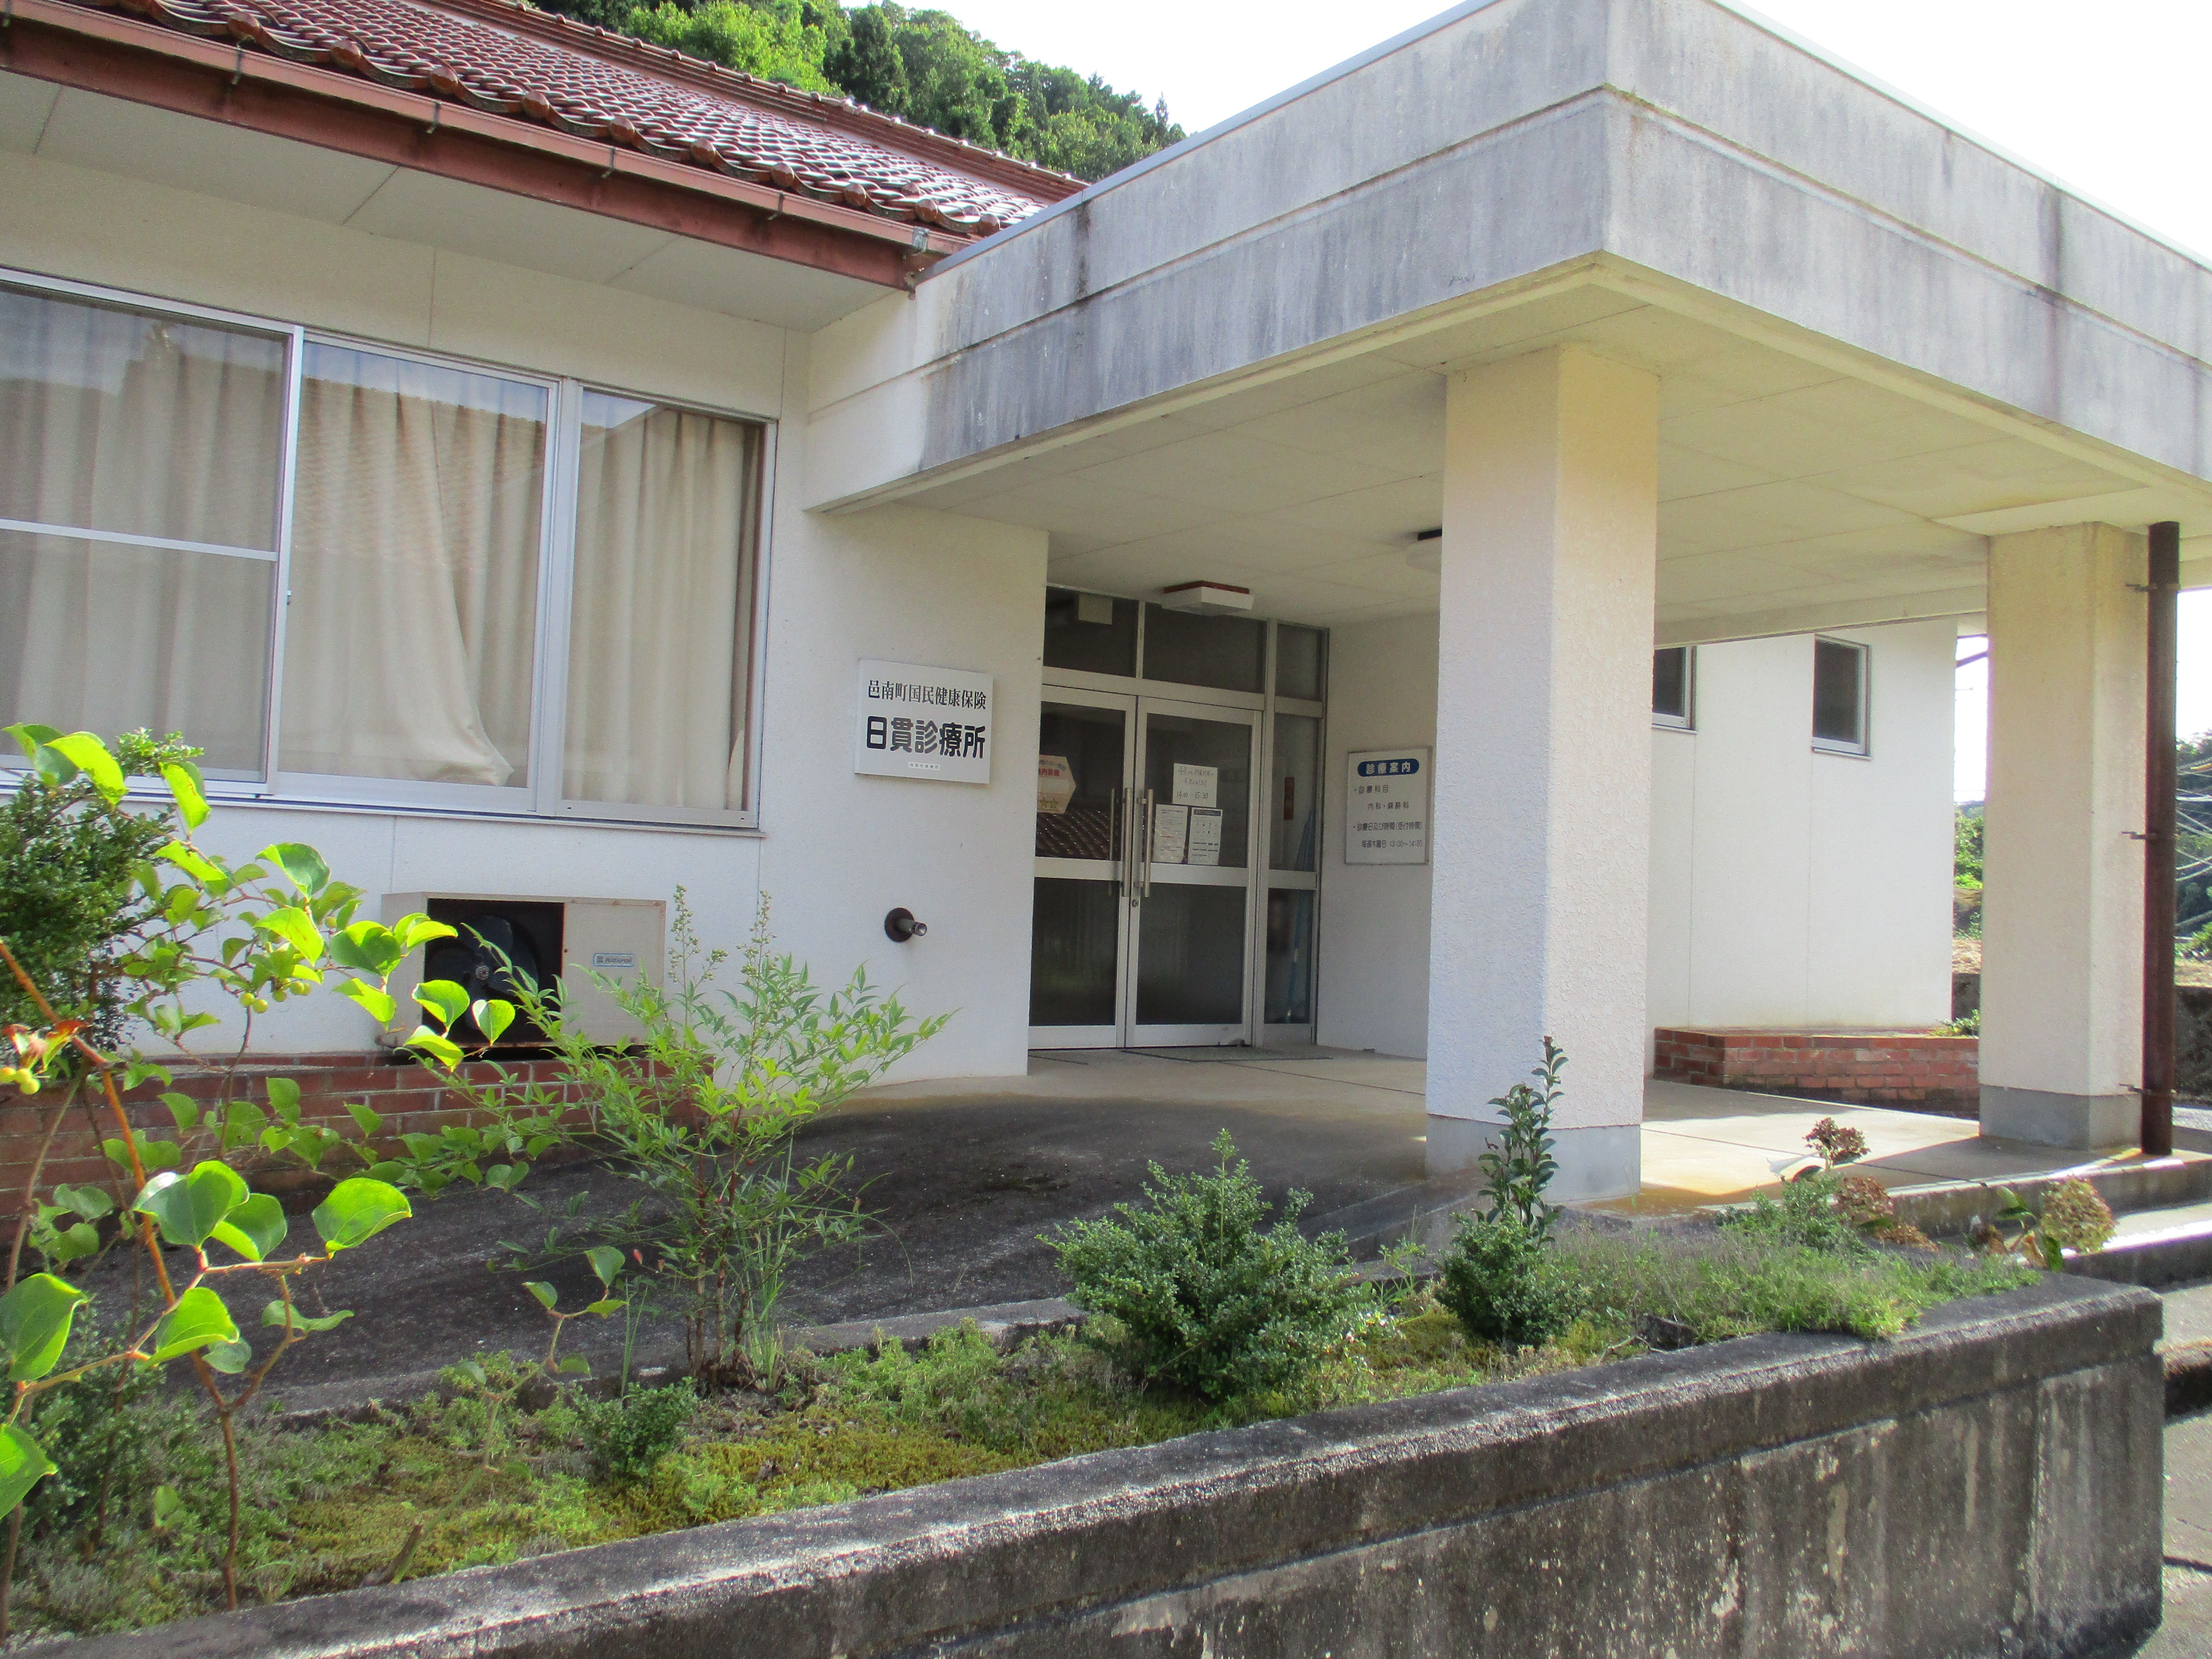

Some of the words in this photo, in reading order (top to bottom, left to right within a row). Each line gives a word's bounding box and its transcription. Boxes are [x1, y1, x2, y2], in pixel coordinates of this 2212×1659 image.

[868, 679, 986, 710] 邑南町国民健康保険
[866, 715, 986, 759] 日貫診療所
[1366, 761, 1410, 775] 診療案内
